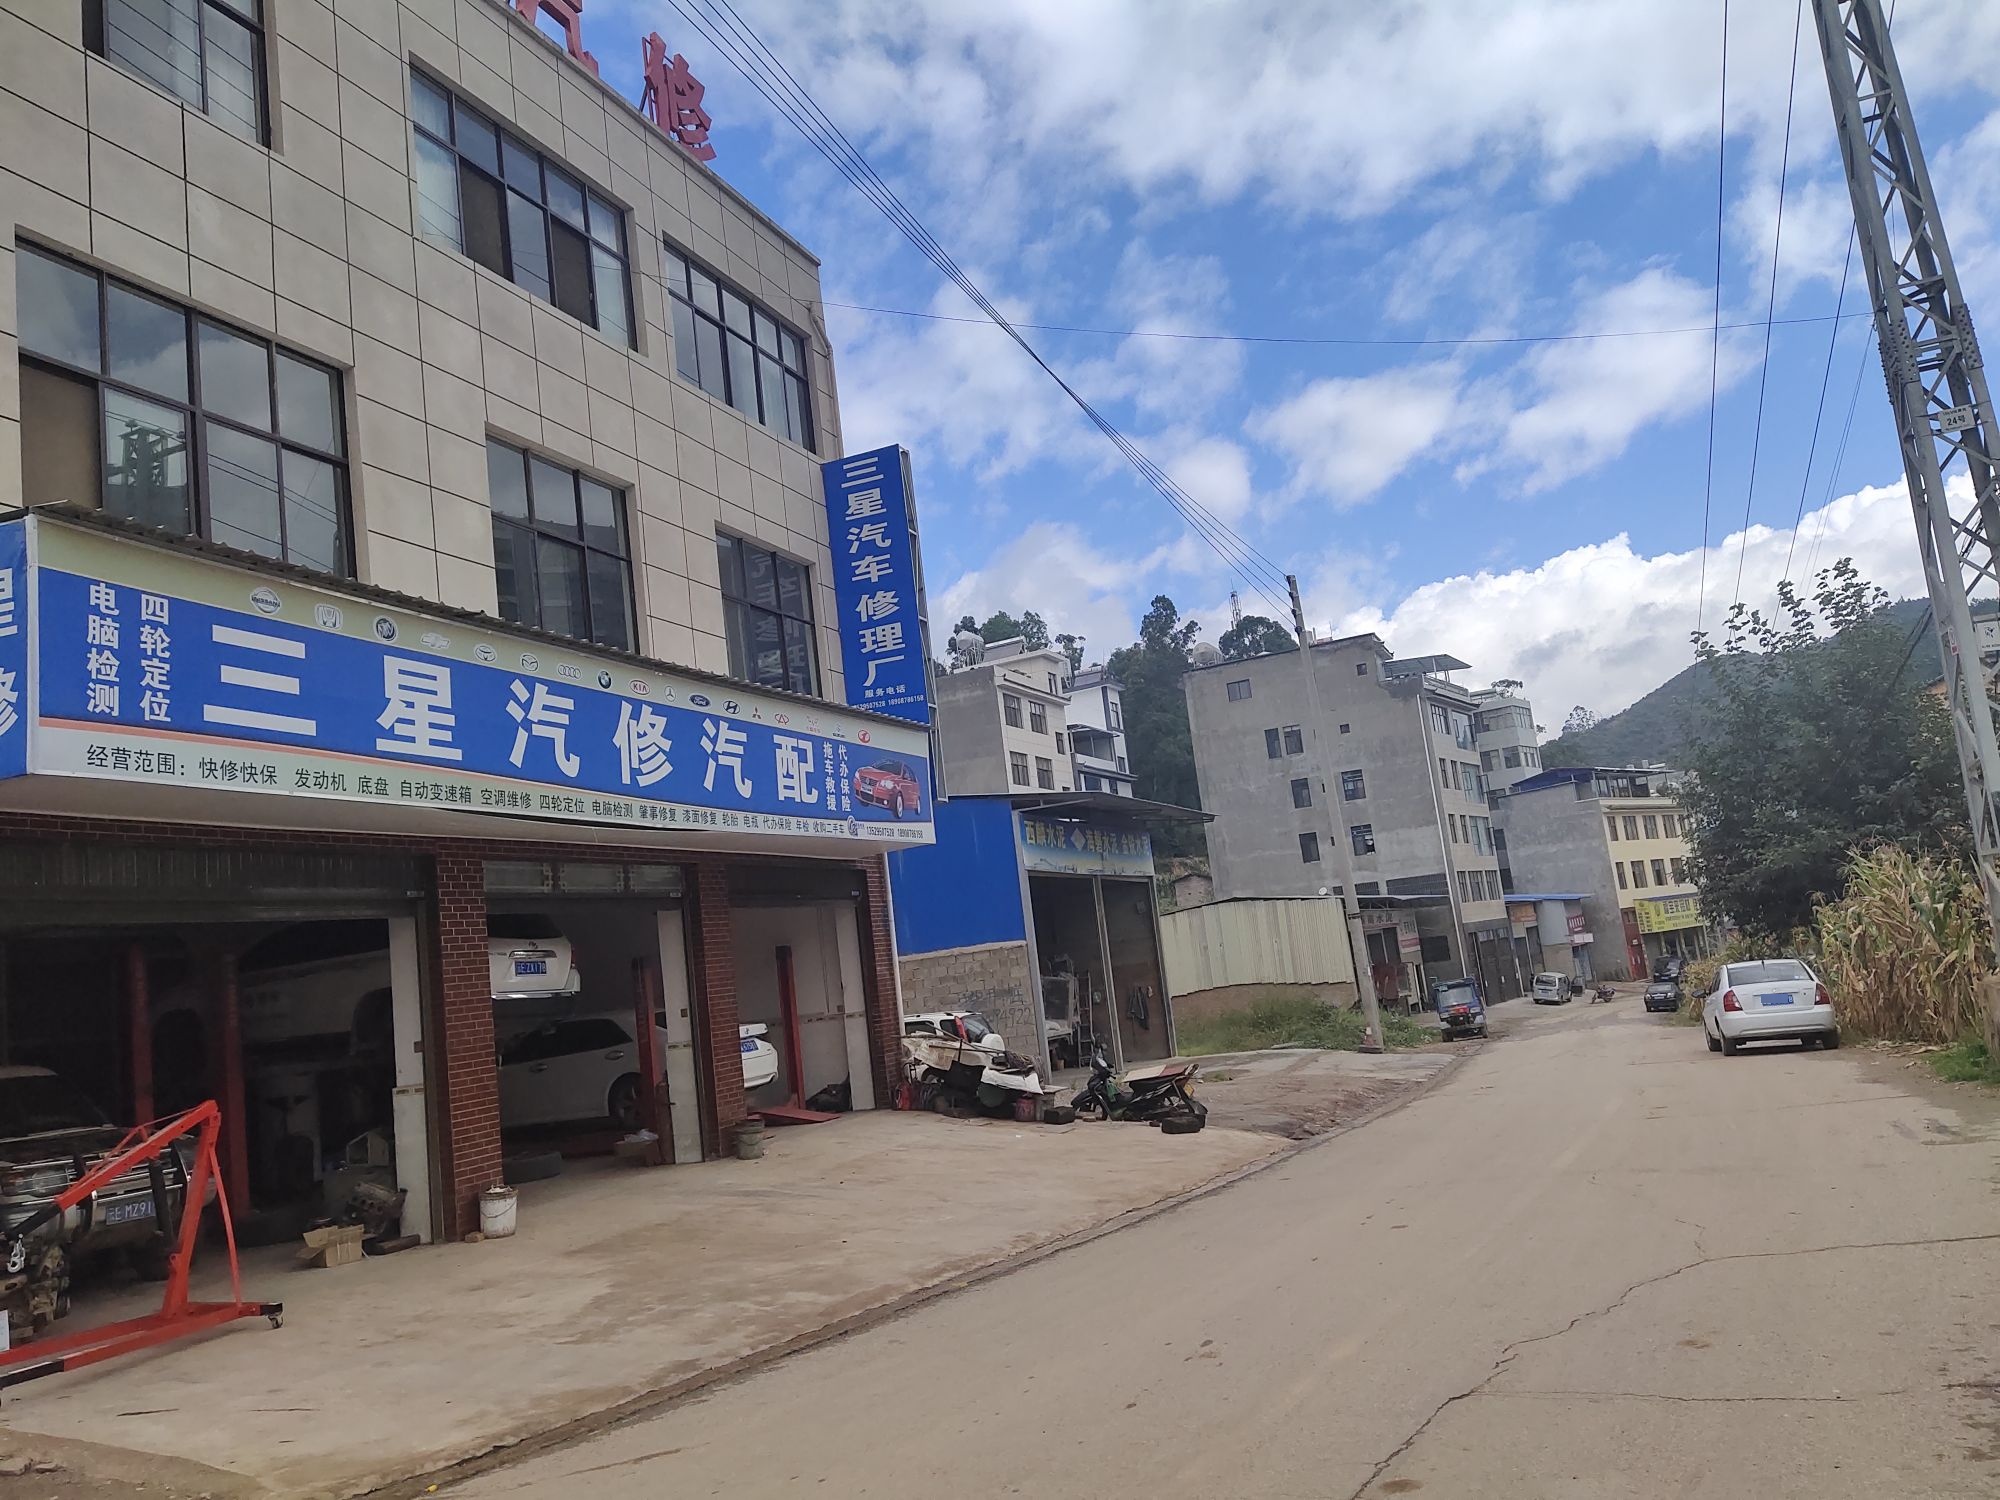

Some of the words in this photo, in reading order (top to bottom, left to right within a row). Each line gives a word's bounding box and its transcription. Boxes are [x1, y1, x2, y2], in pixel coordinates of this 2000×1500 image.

[841, 456, 905, 687] 三星汽车修理厂
[86, 583, 120, 717] 电脑检测
[139, 594, 171, 722] 四轮定位
[203, 624, 818, 804] 三星汽修汽配
[632, 682, 648, 693] KIA
[864, 685, 906, 698] 服务电话
[199, 757, 278, 785] 快修快保
[295, 768, 347, 792] 发动机
[357, 775, 389, 796] 底盘
[400, 779, 472, 804] 自动变速箱
[480, 788, 532, 809] 空调维修
[539, 794, 585, 814] 四轮定位
[592, 799, 633, 818] 电脑检测
[722, 812, 739, 827] 轮胎
[743, 814, 759, 829] 电瓶
[762, 816, 792, 831] 代办保险
[822, 741, 837, 811] 拖车救援
[838, 744, 852, 811] 代办保险
